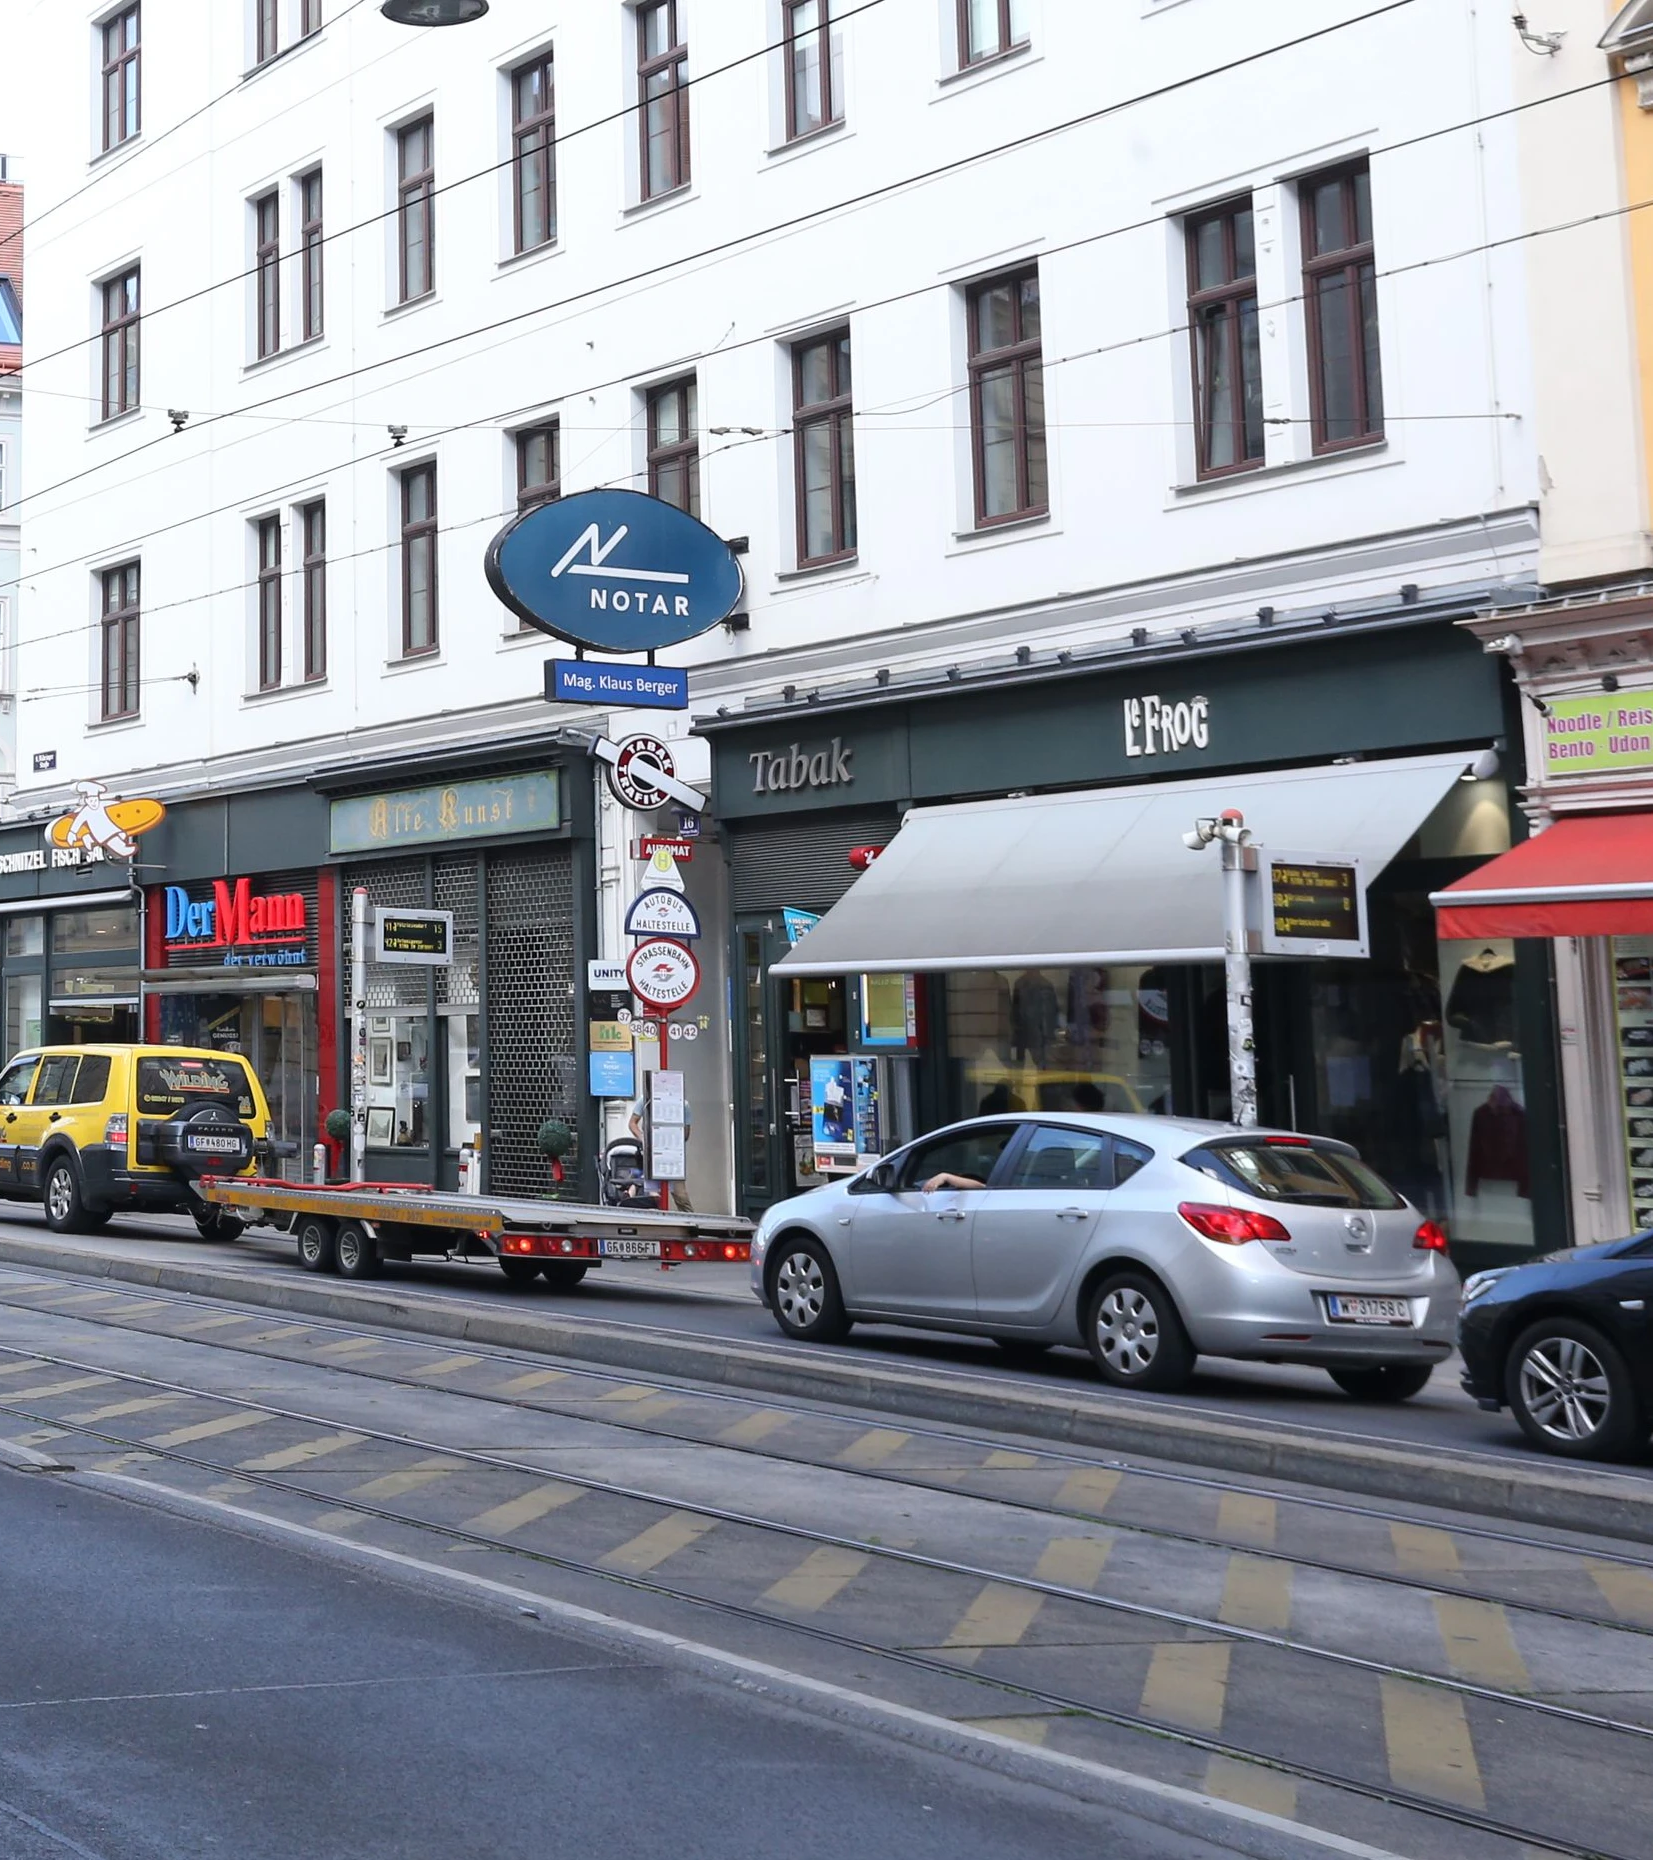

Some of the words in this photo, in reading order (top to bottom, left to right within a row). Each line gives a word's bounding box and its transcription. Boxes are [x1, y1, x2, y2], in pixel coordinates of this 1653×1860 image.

[590, 587, 690, 617] NOTAR
[563, 672, 596, 691] Mag.
[599, 674, 633, 692] Klaus
[636, 677, 679, 697] Berger
[1547, 713, 1602, 734] Noodle
[1617, 707, 1653, 727] Reis
[626, 739, 674, 771] TABAK
[1548, 740, 1594, 760] Bento
[1609, 734, 1651, 754] Udon
[748, 736, 854, 793] Tabak
[618, 765, 662, 805] TRAFIK
[682, 816, 695, 830] 16
[51, 847, 81, 869] FISCH
[645, 843, 691, 857] AUTOMAT
[644, 894, 685, 914] AUTOBUS
[434, 924, 443, 934] 15
[636, 919, 691, 933] HALTESTELLE
[247, 947, 308, 967] verwöhnt
[635, 945, 692, 971] STRASSENBAHN
[593, 969, 626, 978] UNITY
[637, 979, 689, 1000] HALTESTELLE
[619, 1012, 631, 1022] 37
[630, 1025, 642, 1034] 38
[643, 1025, 656, 1035] 40
[669, 1027, 681, 1036] 41
[683, 1027, 696, 1037] 42
[1360, 1301, 1394, 1317] 31758
[1397, 1302, 1406, 1317] C
